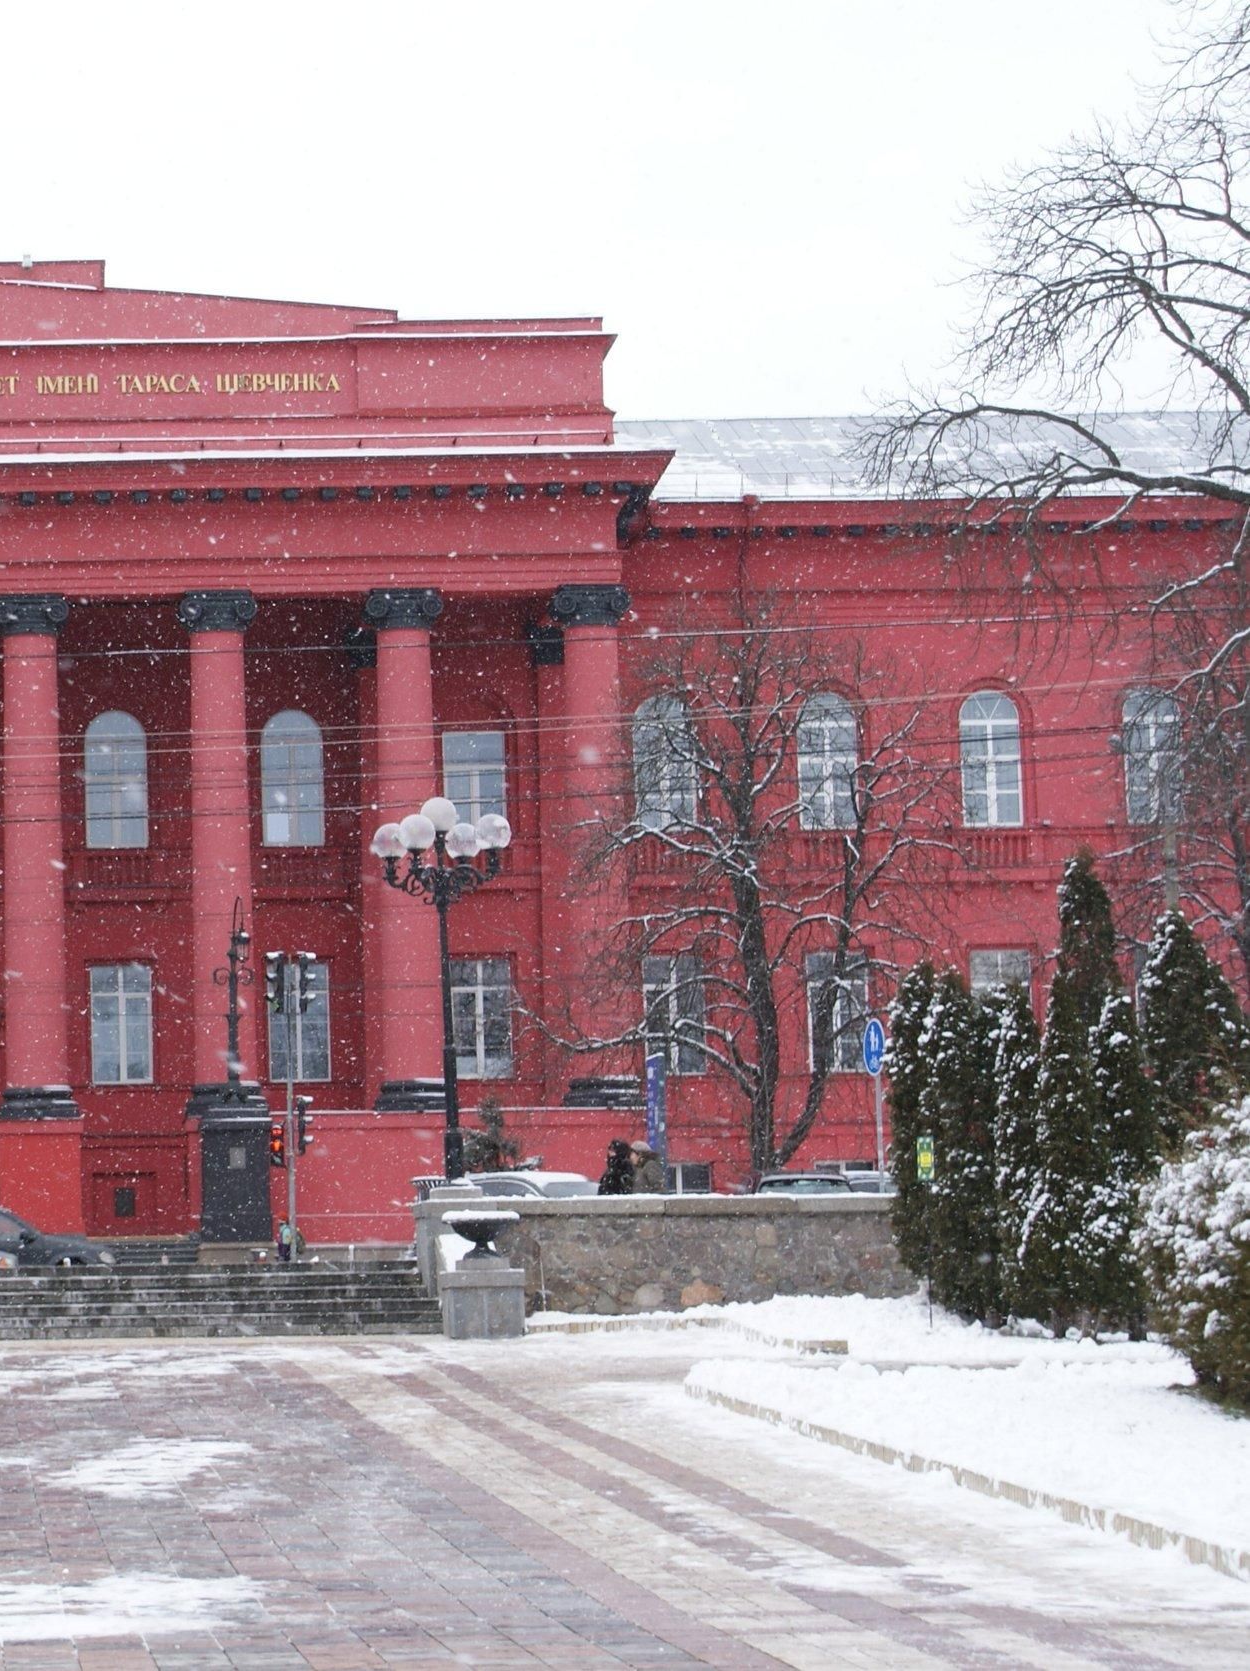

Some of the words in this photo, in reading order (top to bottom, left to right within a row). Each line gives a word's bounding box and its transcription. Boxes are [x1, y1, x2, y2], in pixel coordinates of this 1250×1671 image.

[36, 374, 99, 395] ІМЕНІ
[117, 373, 200, 393] ТАРАСА
[216, 372, 341, 394] ШЕВЧЕНКА
